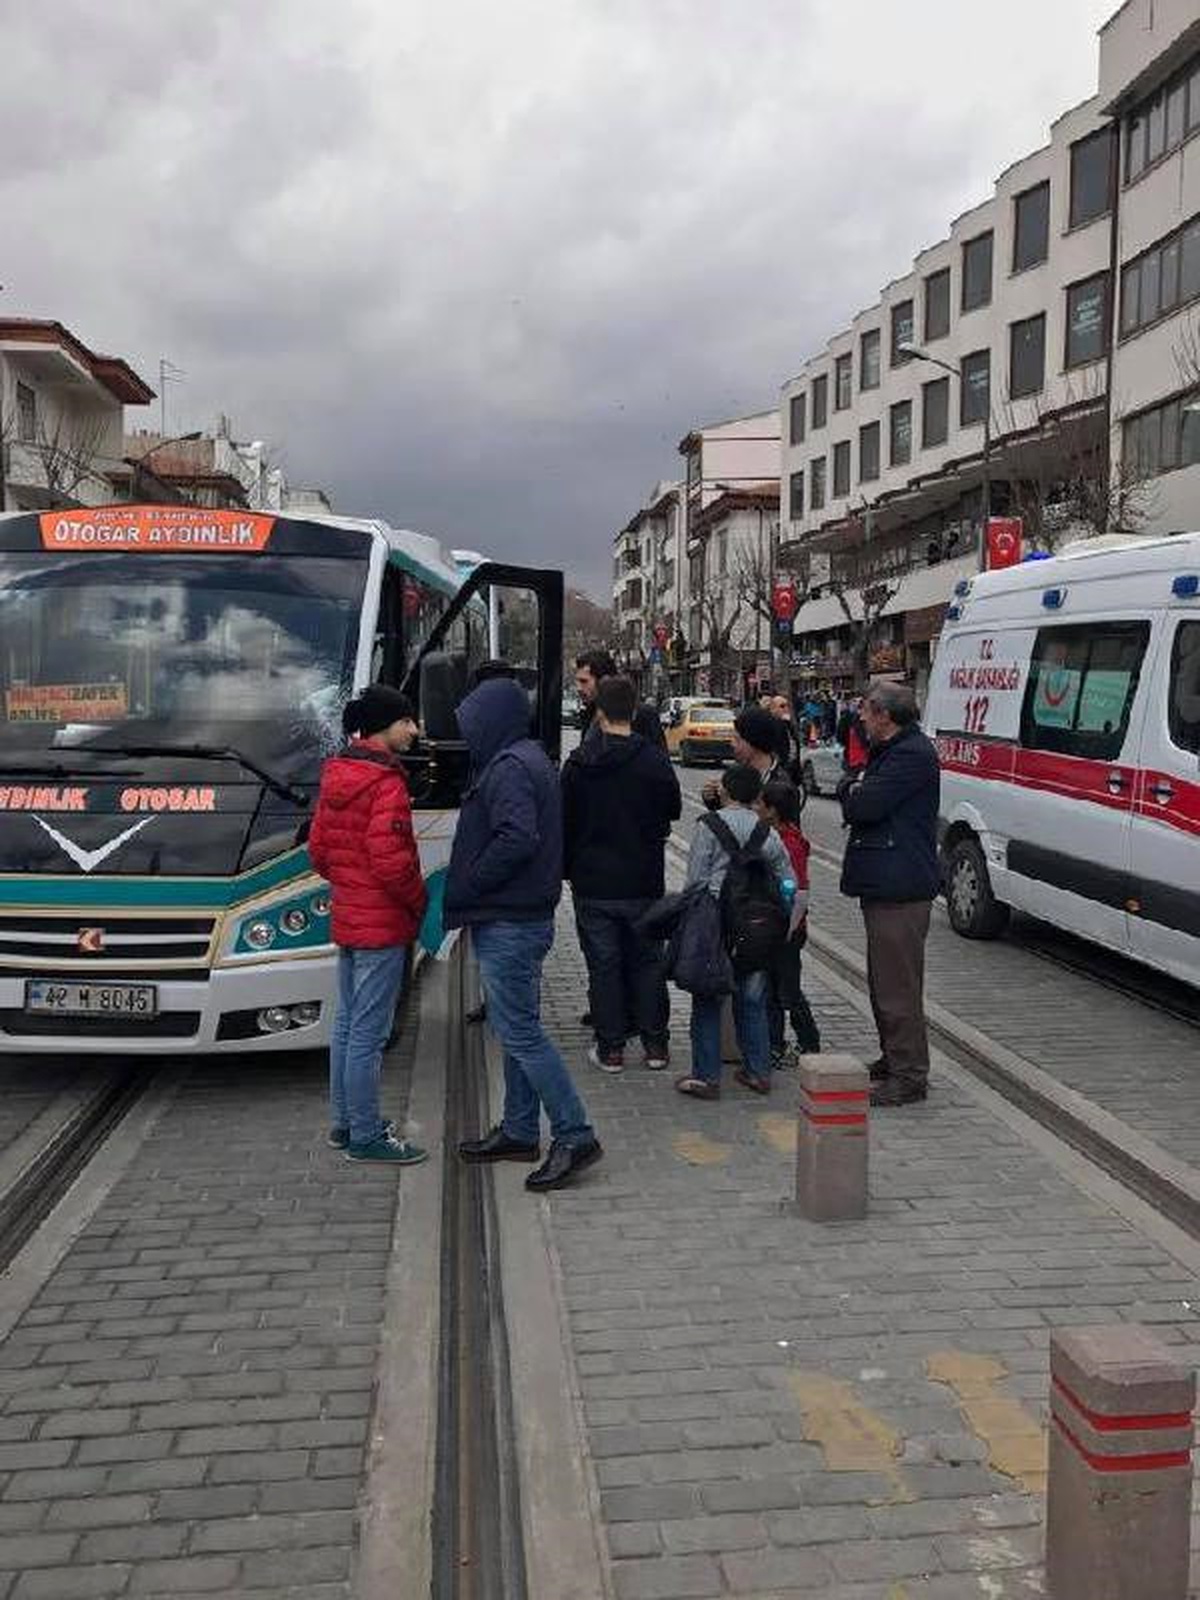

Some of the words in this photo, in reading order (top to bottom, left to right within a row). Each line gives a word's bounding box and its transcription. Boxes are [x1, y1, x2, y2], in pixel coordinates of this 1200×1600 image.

[54, 519, 140, 542] OTOGAR
[149, 521, 254, 545] AYDINLIK
[965, 696, 989, 732] 112
[120, 787, 215, 811] OTOGAR
[45, 986, 67, 1007] 42
[99, 989, 147, 1011] 8045
